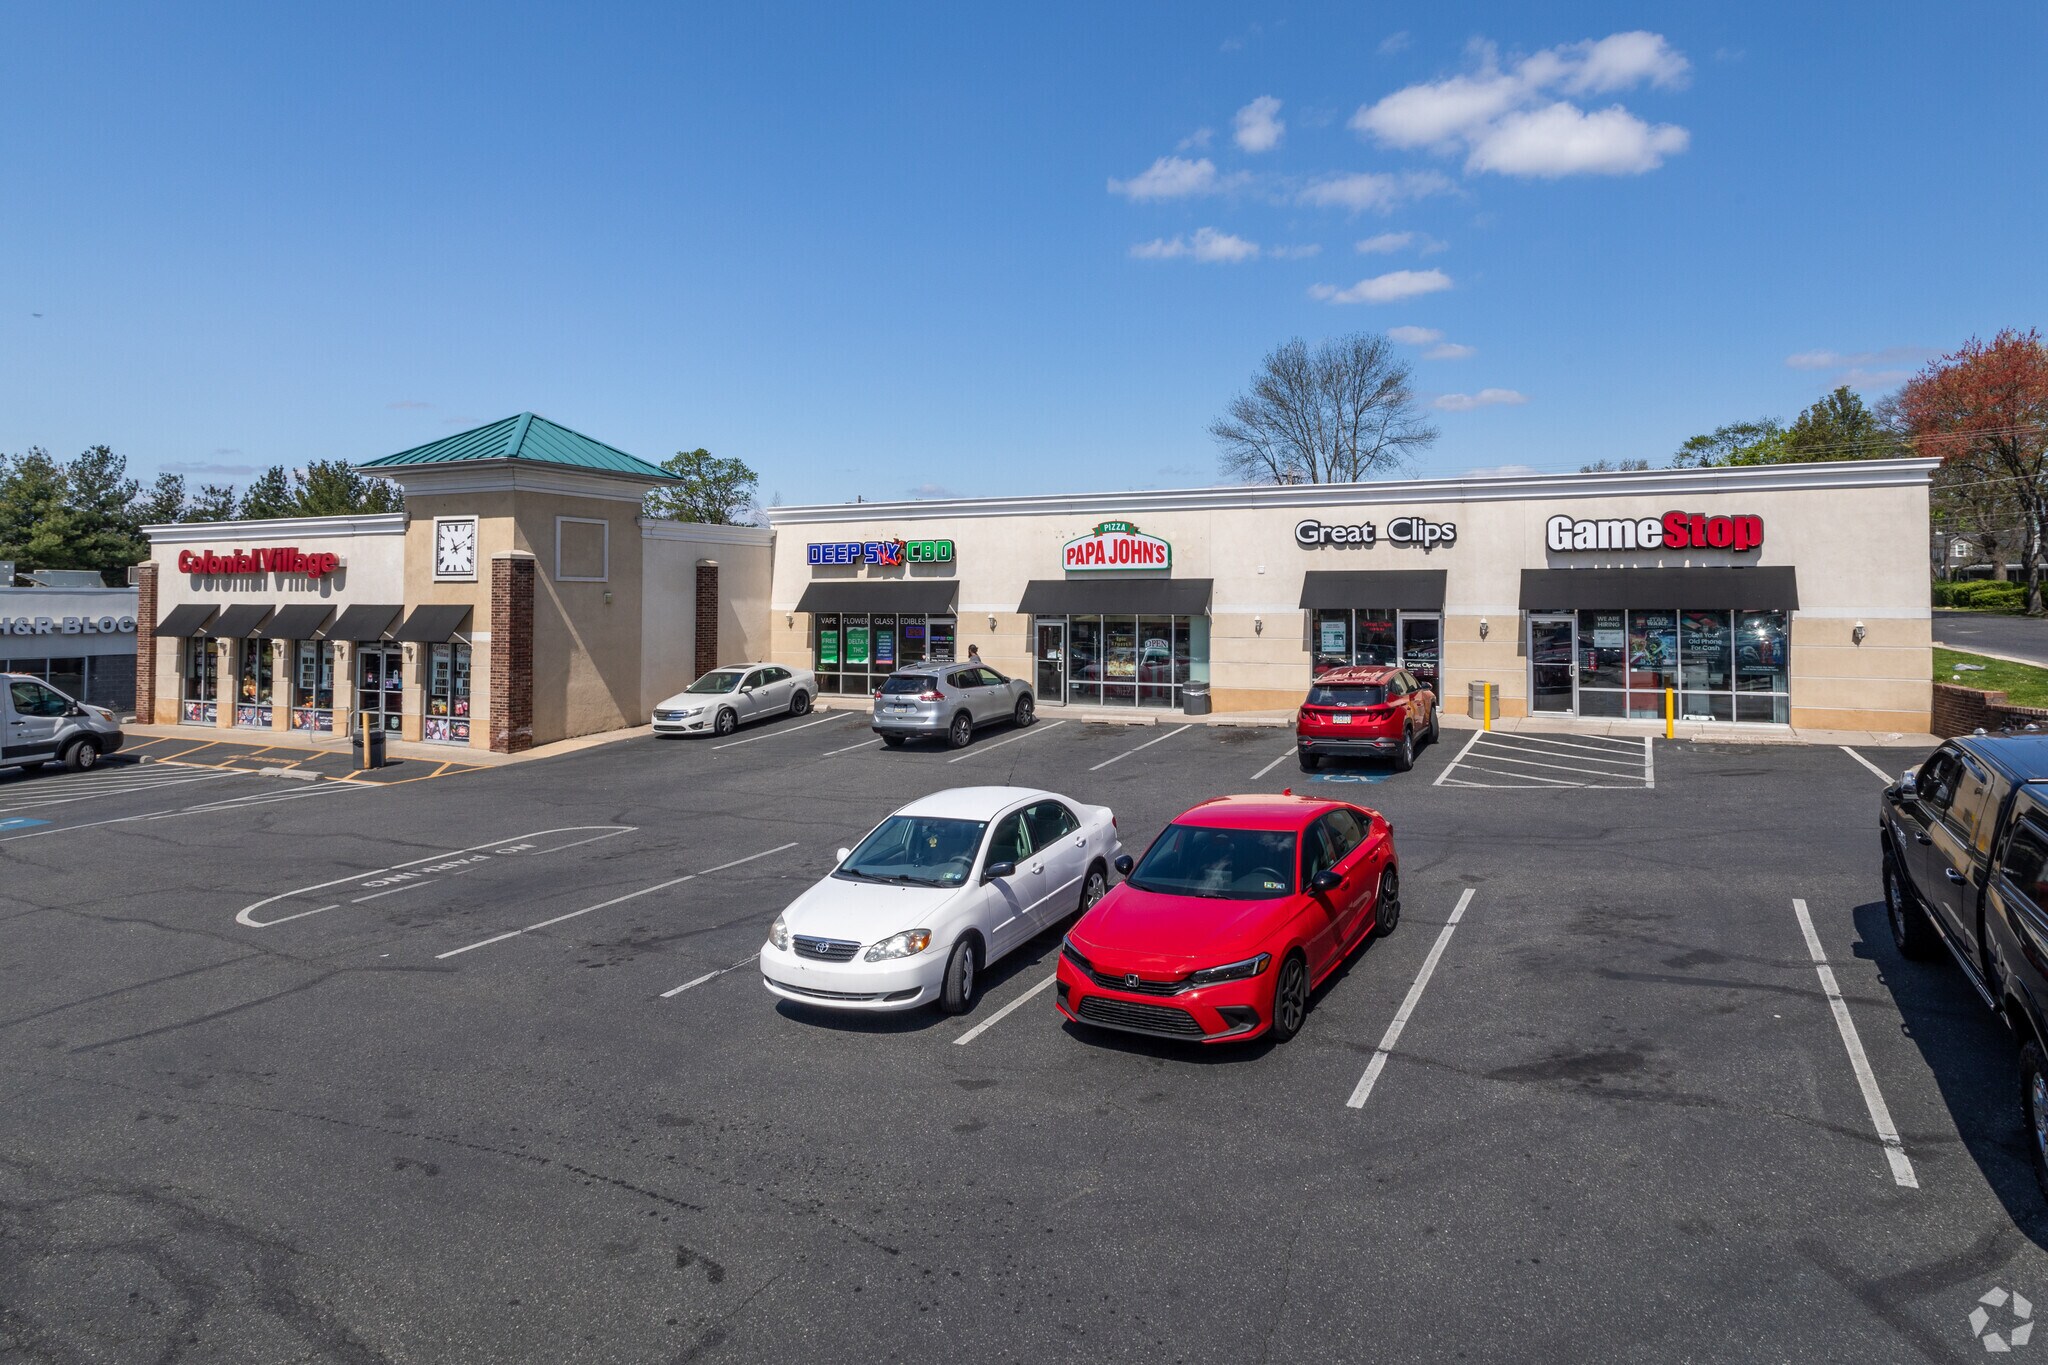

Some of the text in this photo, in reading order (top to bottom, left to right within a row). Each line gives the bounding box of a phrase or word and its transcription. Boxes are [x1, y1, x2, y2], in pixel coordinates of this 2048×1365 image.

[1296, 517, 1455, 547] Great Clips
[1547, 511, 1763, 551] GameStop
[178, 548, 339, 578] Colonial Village
[808, 542, 862, 565] DEEP
[906, 540, 952, 562] CBD
[1067, 538, 1165, 564] PAPA JOHN'S
[0, 616, 135, 635] H&R BLOC
[362, 855, 490, 888] PARKING
